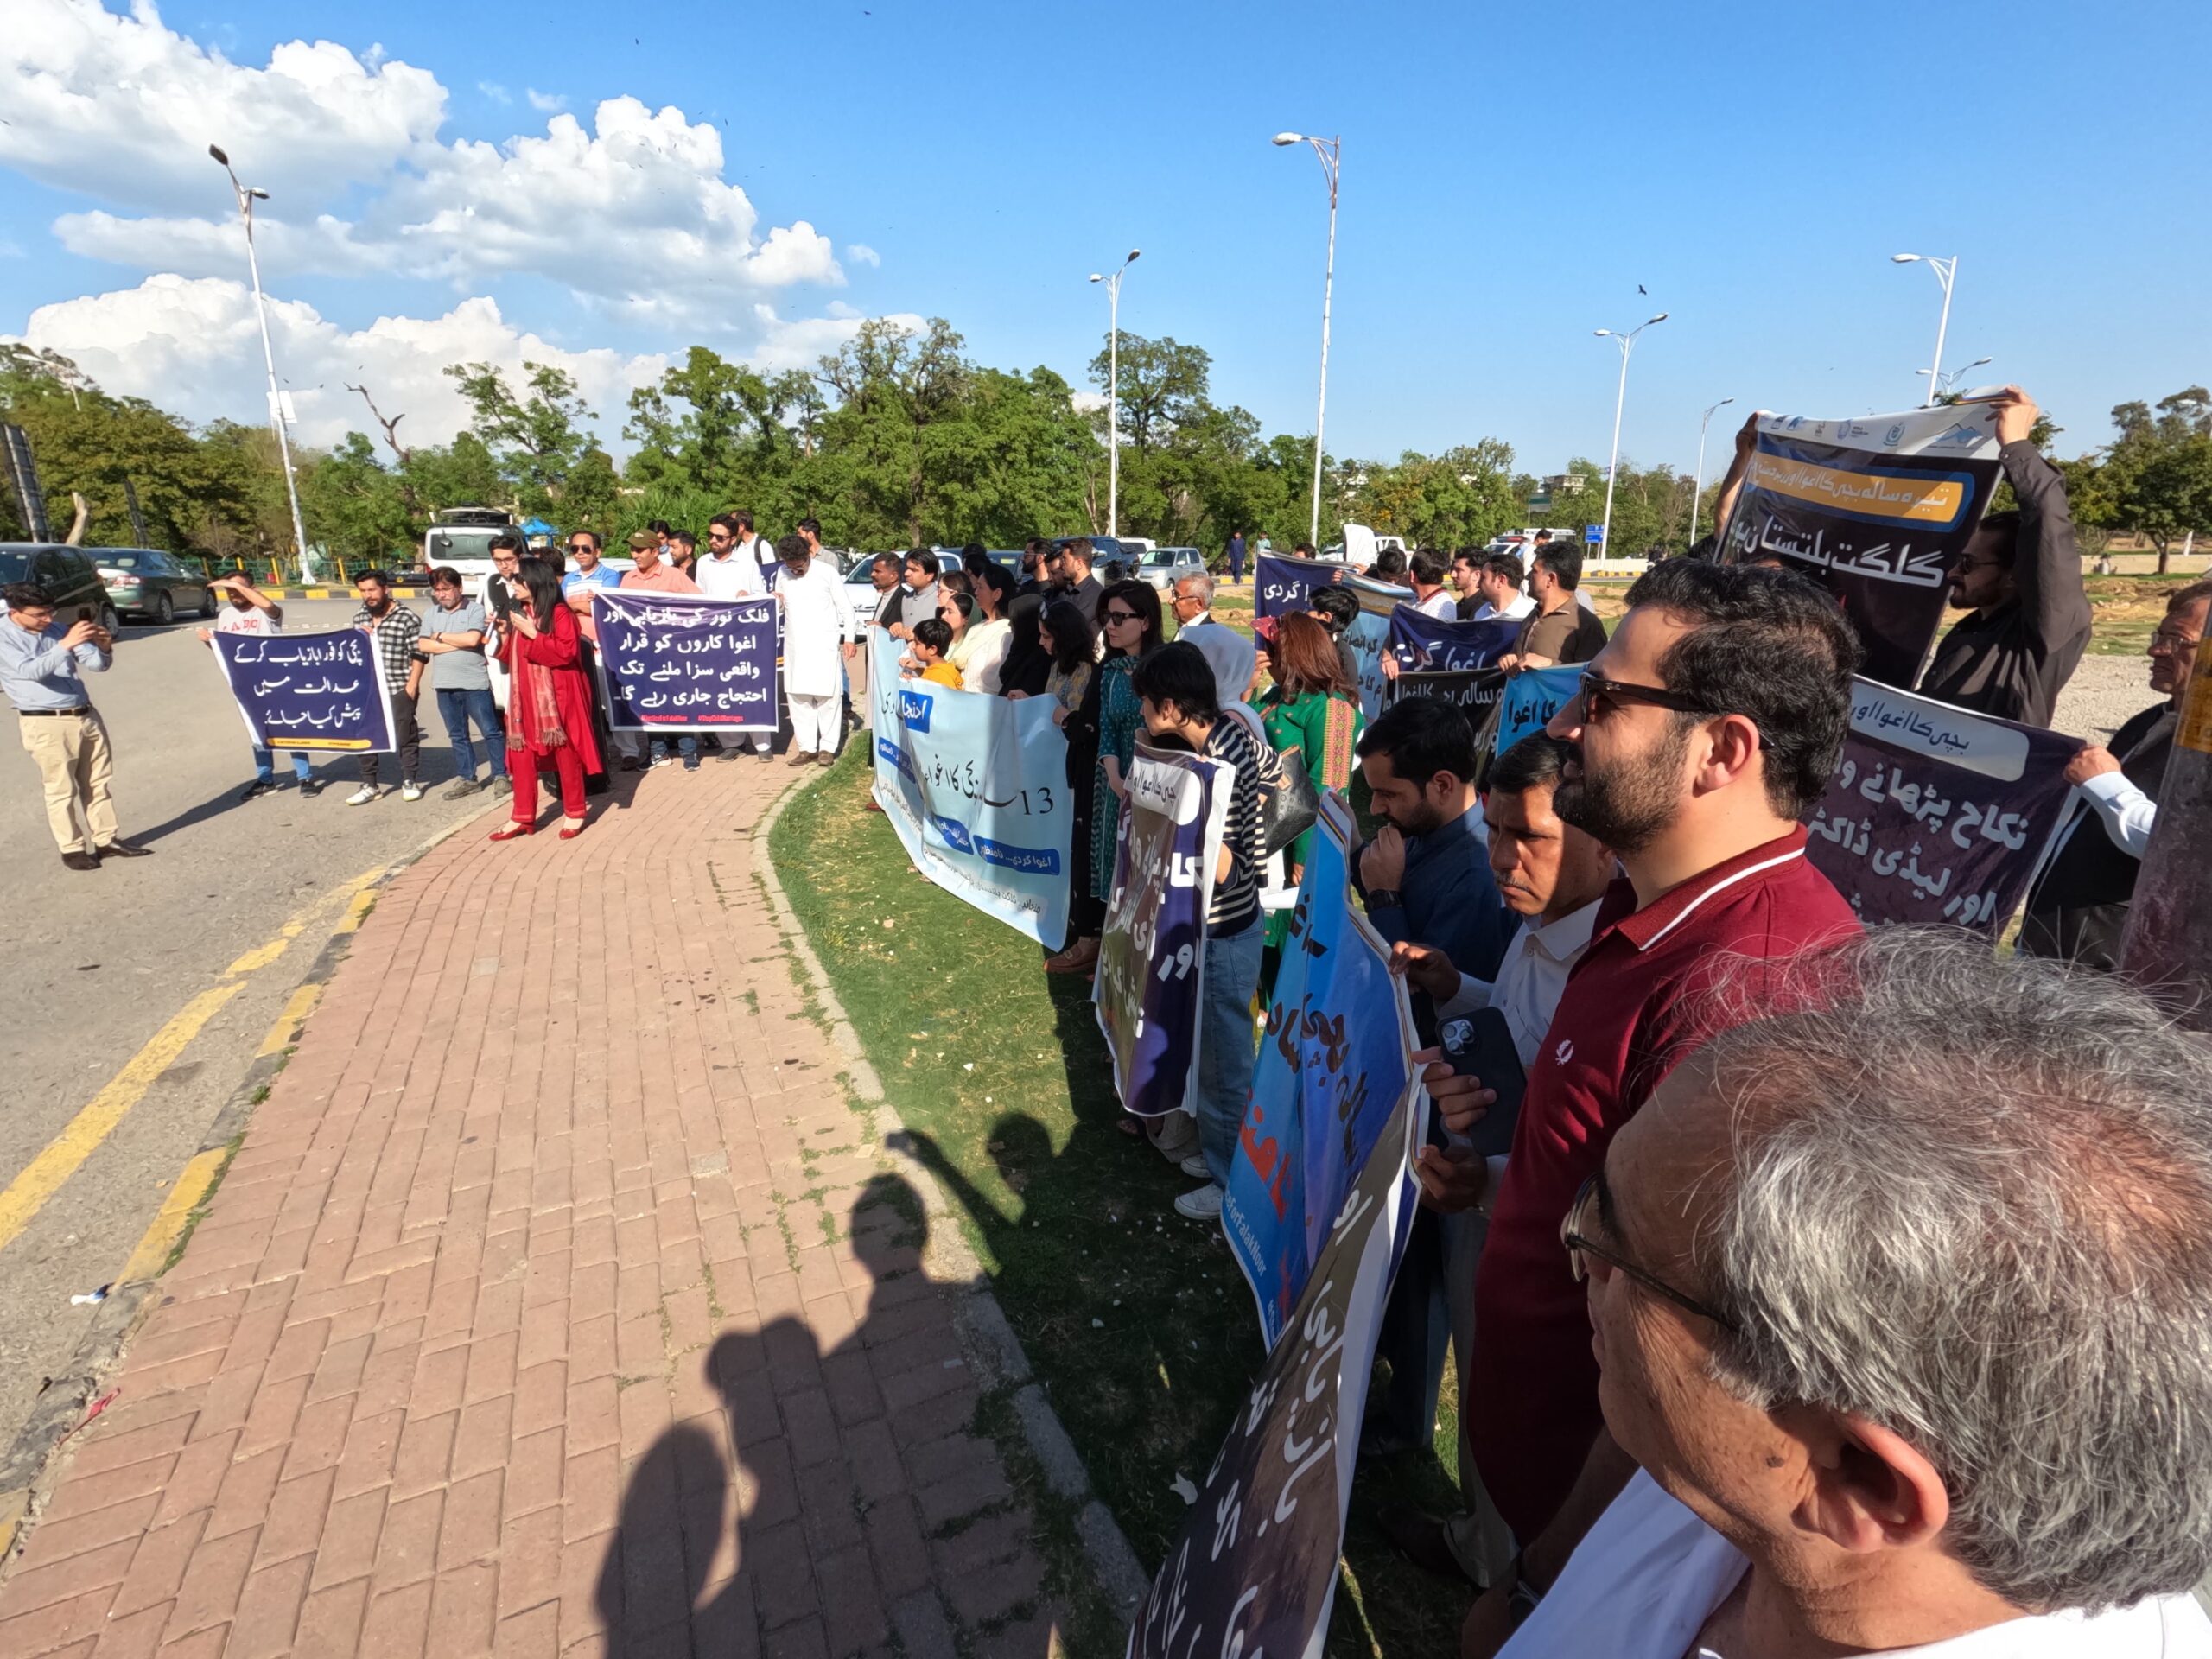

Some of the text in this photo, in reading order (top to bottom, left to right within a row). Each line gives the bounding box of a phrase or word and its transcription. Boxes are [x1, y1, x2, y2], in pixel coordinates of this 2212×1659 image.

[1831, 543, 1945, 588] گلگت
[709, 610, 733, 627] نور
[737, 607, 771, 624] فلک
[619, 632, 756, 654] اغوا کاروں کو قرار
[620, 660, 760, 682] واقعی سزا ملنے تک
[253, 675, 359, 696] عدالت میں
[672, 686, 712, 706] جاری
[717, 686, 768, 709] احتجاج
[1020, 786, 1054, 816] 13
[1950, 801, 2030, 851] نکاح
[1872, 841, 1952, 900] لیڈی
[1943, 890, 1997, 926] اور
